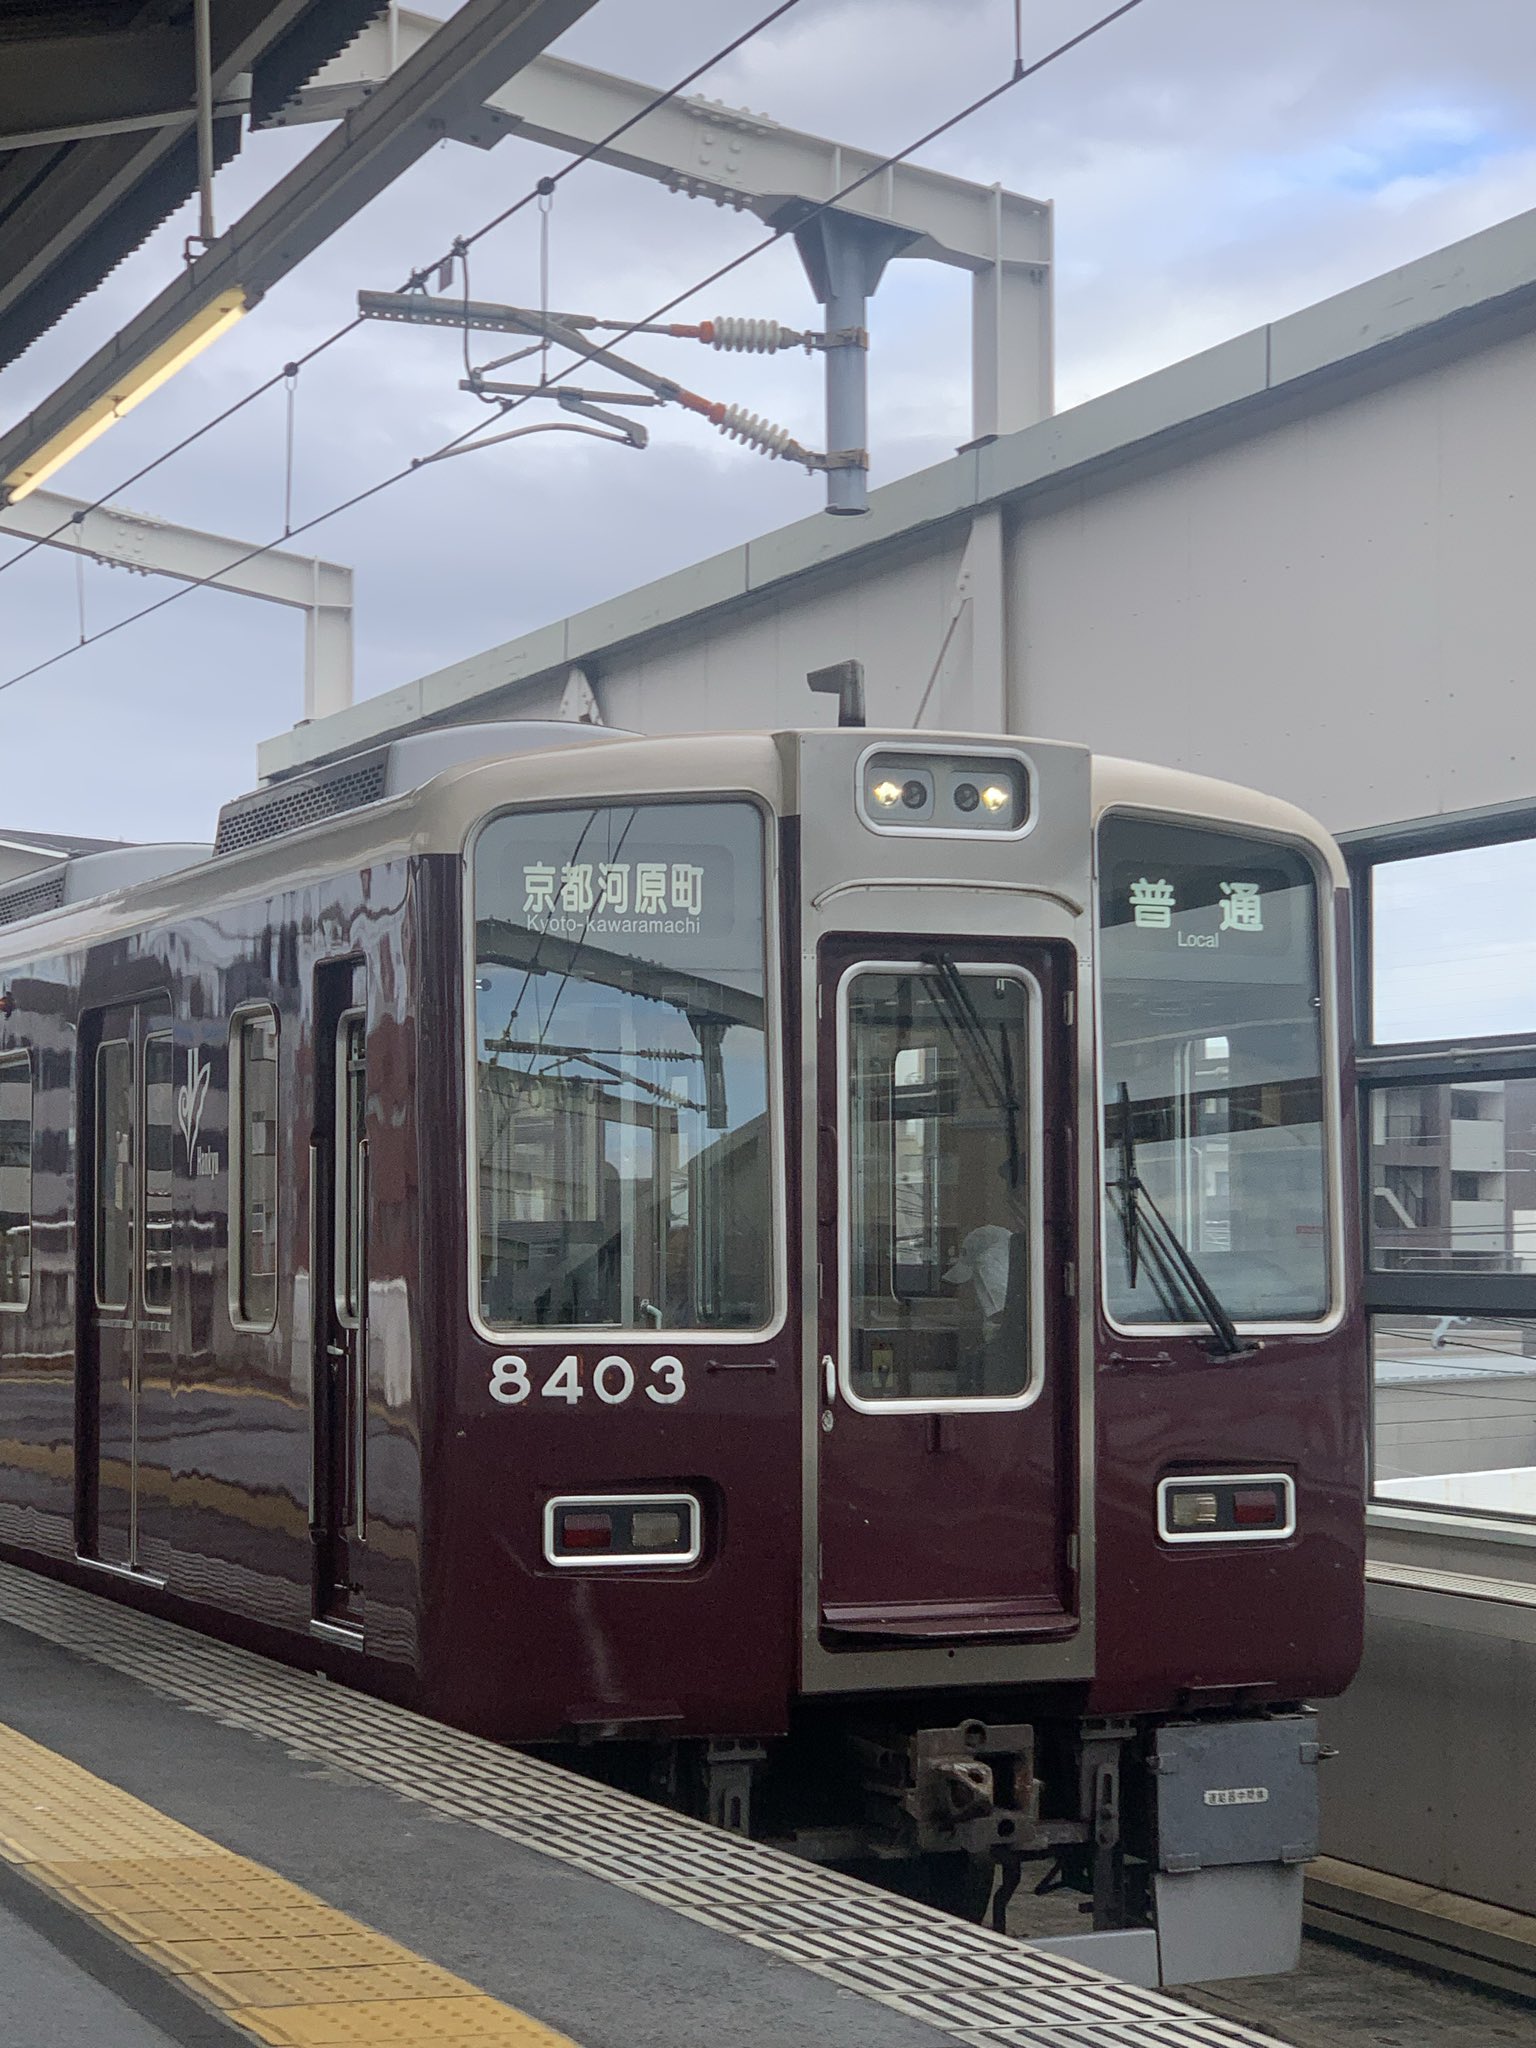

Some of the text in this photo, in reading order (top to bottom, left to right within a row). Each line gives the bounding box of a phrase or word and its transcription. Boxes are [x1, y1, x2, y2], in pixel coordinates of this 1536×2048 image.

[522, 860, 704, 915] 京都河原町
[527, 914, 701, 935] Kyoto-kawaramachi
[1177, 930, 1220, 948] Local
[488, 1355, 686, 1404] 8403
